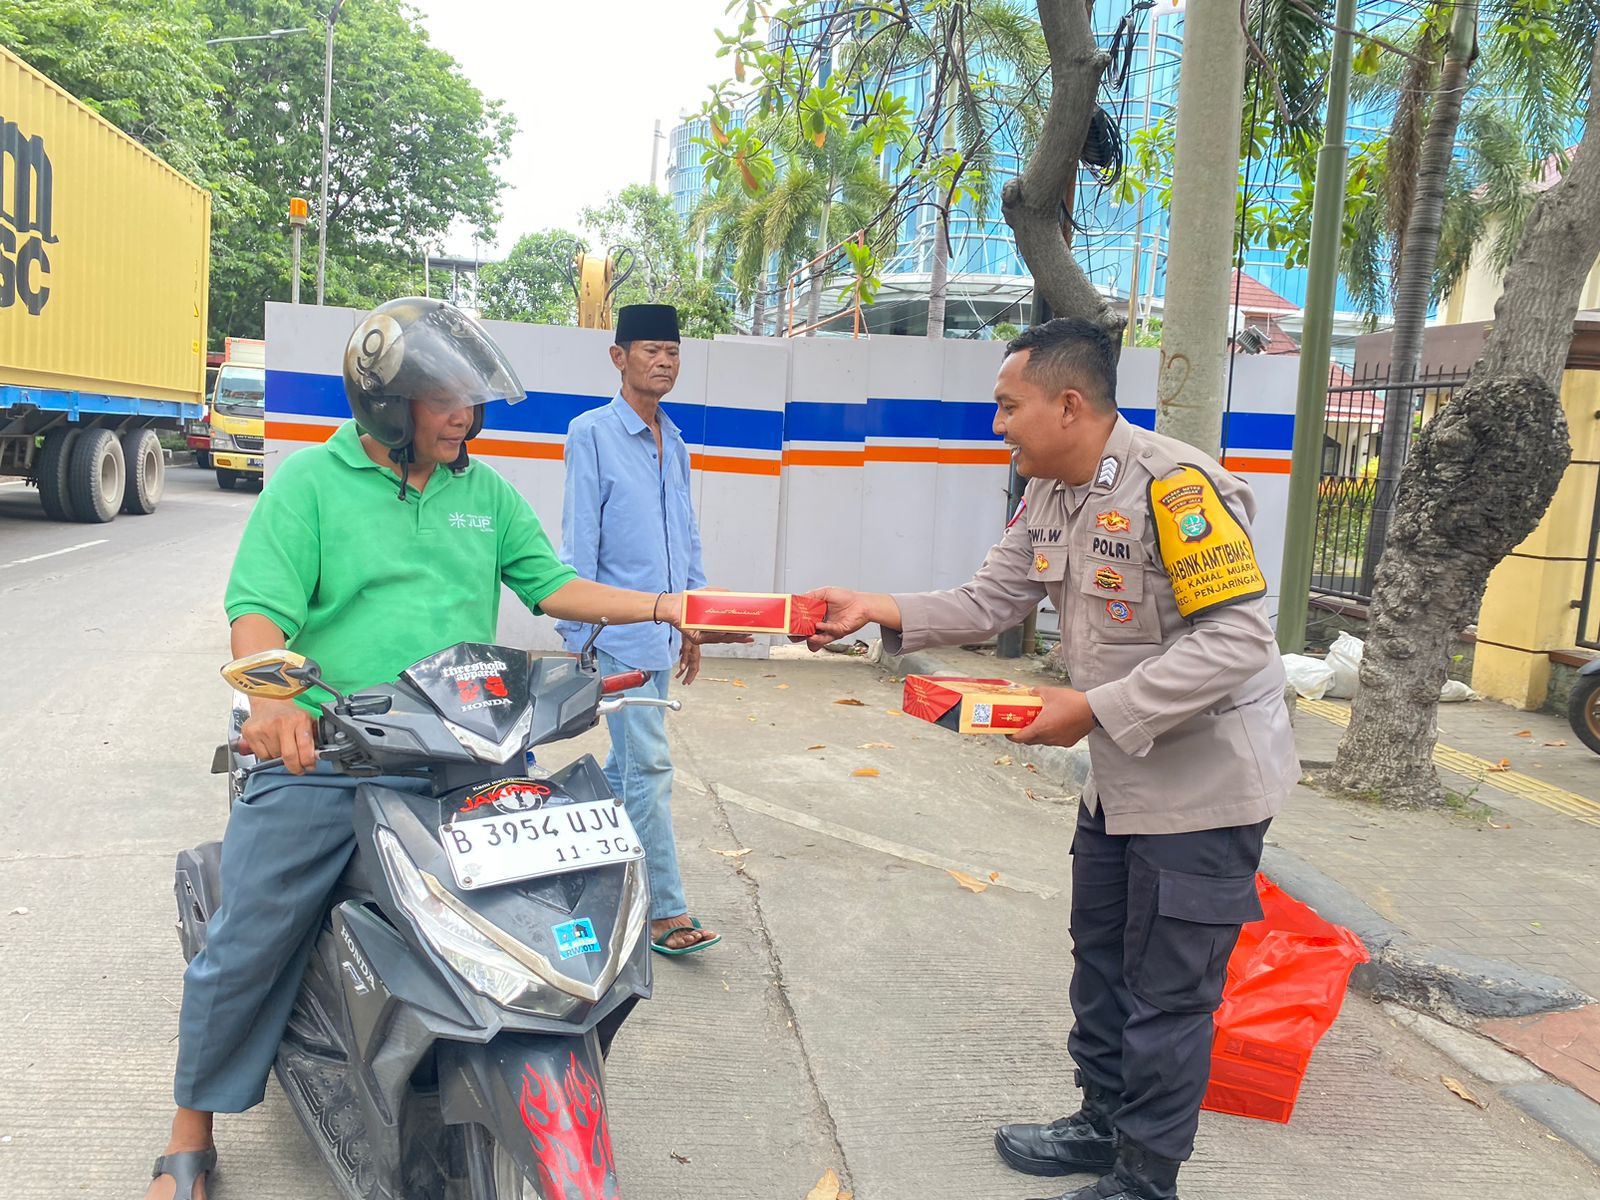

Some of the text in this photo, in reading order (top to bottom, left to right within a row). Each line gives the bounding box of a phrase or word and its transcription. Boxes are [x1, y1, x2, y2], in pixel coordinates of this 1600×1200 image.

[1093, 537, 1131, 559] POLRI
[1187, 571, 1224, 589] KAMAL
[442, 660, 508, 677] threshold
[456, 669, 500, 681] apparel
[461, 697, 513, 712] HONDA
[459, 784, 552, 813] JAKPRO
[451, 807, 620, 854] B 3954 UJV
[341, 924, 376, 991] HONDA
